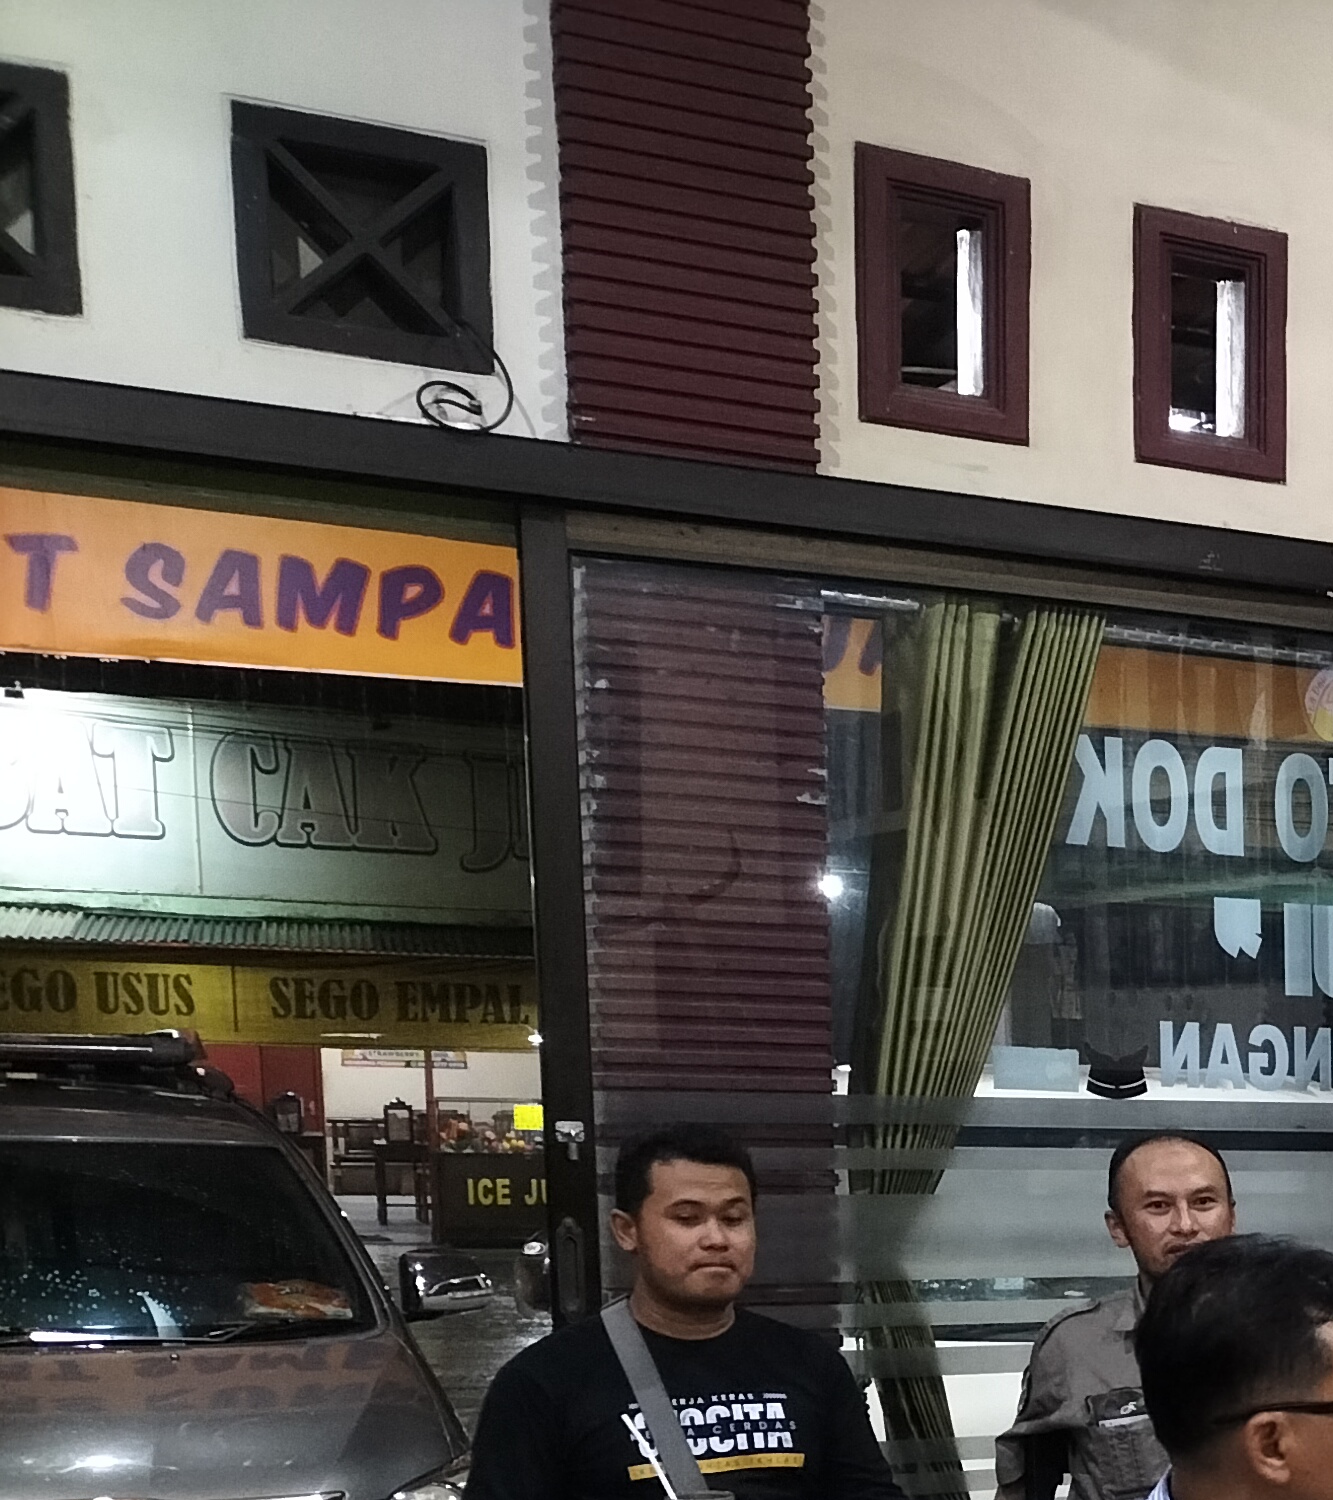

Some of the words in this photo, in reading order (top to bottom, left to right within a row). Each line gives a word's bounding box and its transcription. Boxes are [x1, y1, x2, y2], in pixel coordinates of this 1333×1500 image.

[121, 541, 517, 649] SAMPA
[208, 727, 438, 855] CAK
[93, 970, 196, 1018] USUS
[269, 975, 381, 1022] SEGO
[394, 979, 531, 1025] EMPAL
[466, 1178, 512, 1206] ICE
[711, 1420, 798, 1435] CERDAS
